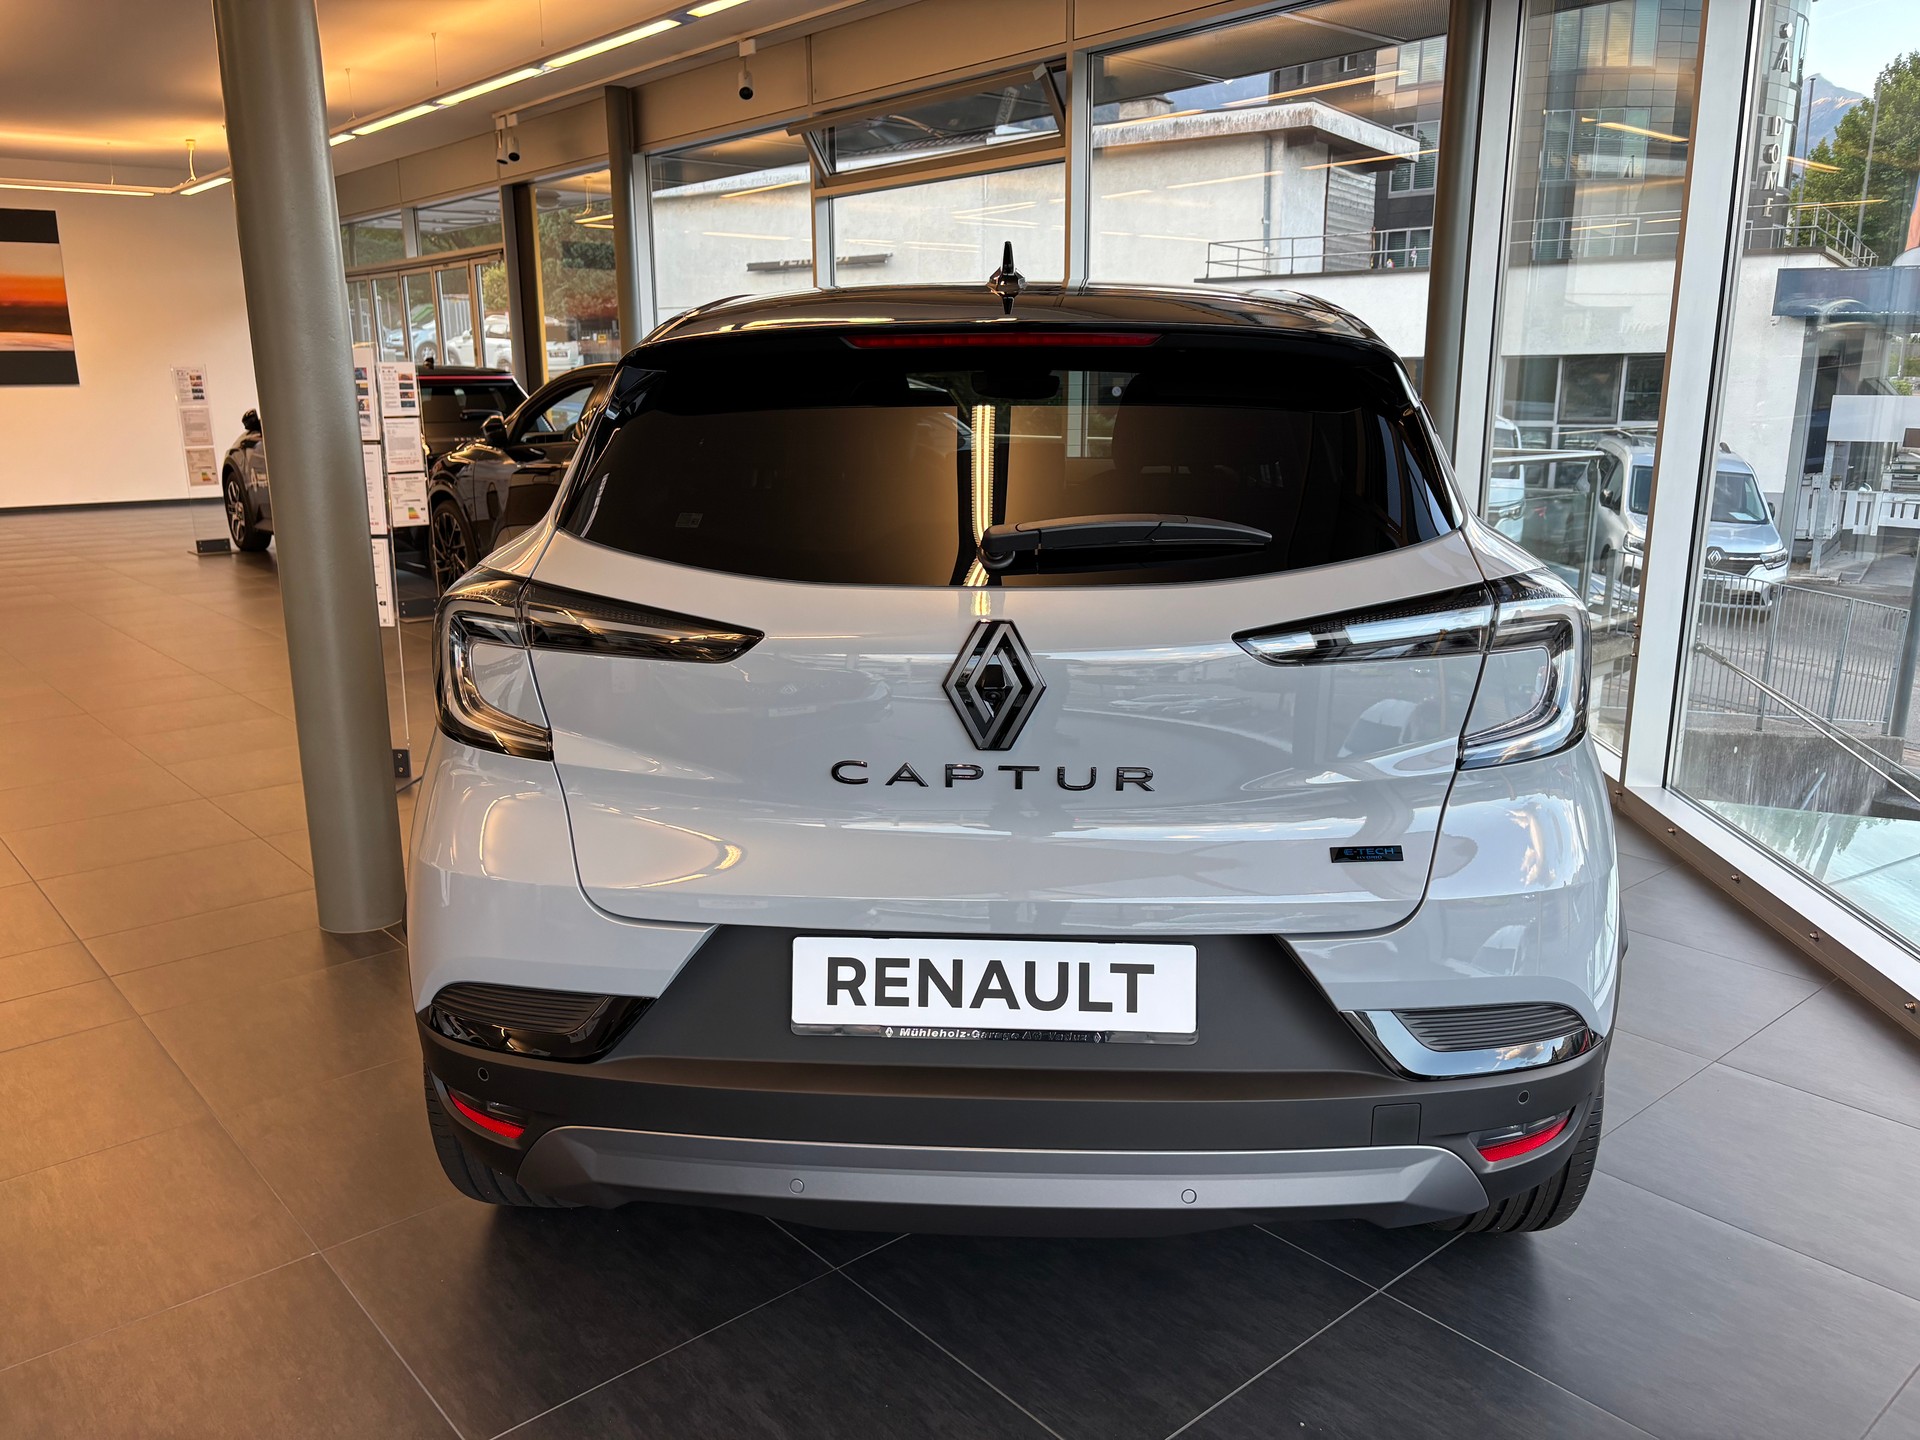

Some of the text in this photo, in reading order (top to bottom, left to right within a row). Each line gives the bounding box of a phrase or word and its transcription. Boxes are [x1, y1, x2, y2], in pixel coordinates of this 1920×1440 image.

[1763, 115, 1783, 218] DOME
[831, 759, 1156, 792] CAPTUR
[1343, 848, 1394, 856] E-TECH
[826, 956, 1155, 1014] RENAULT
